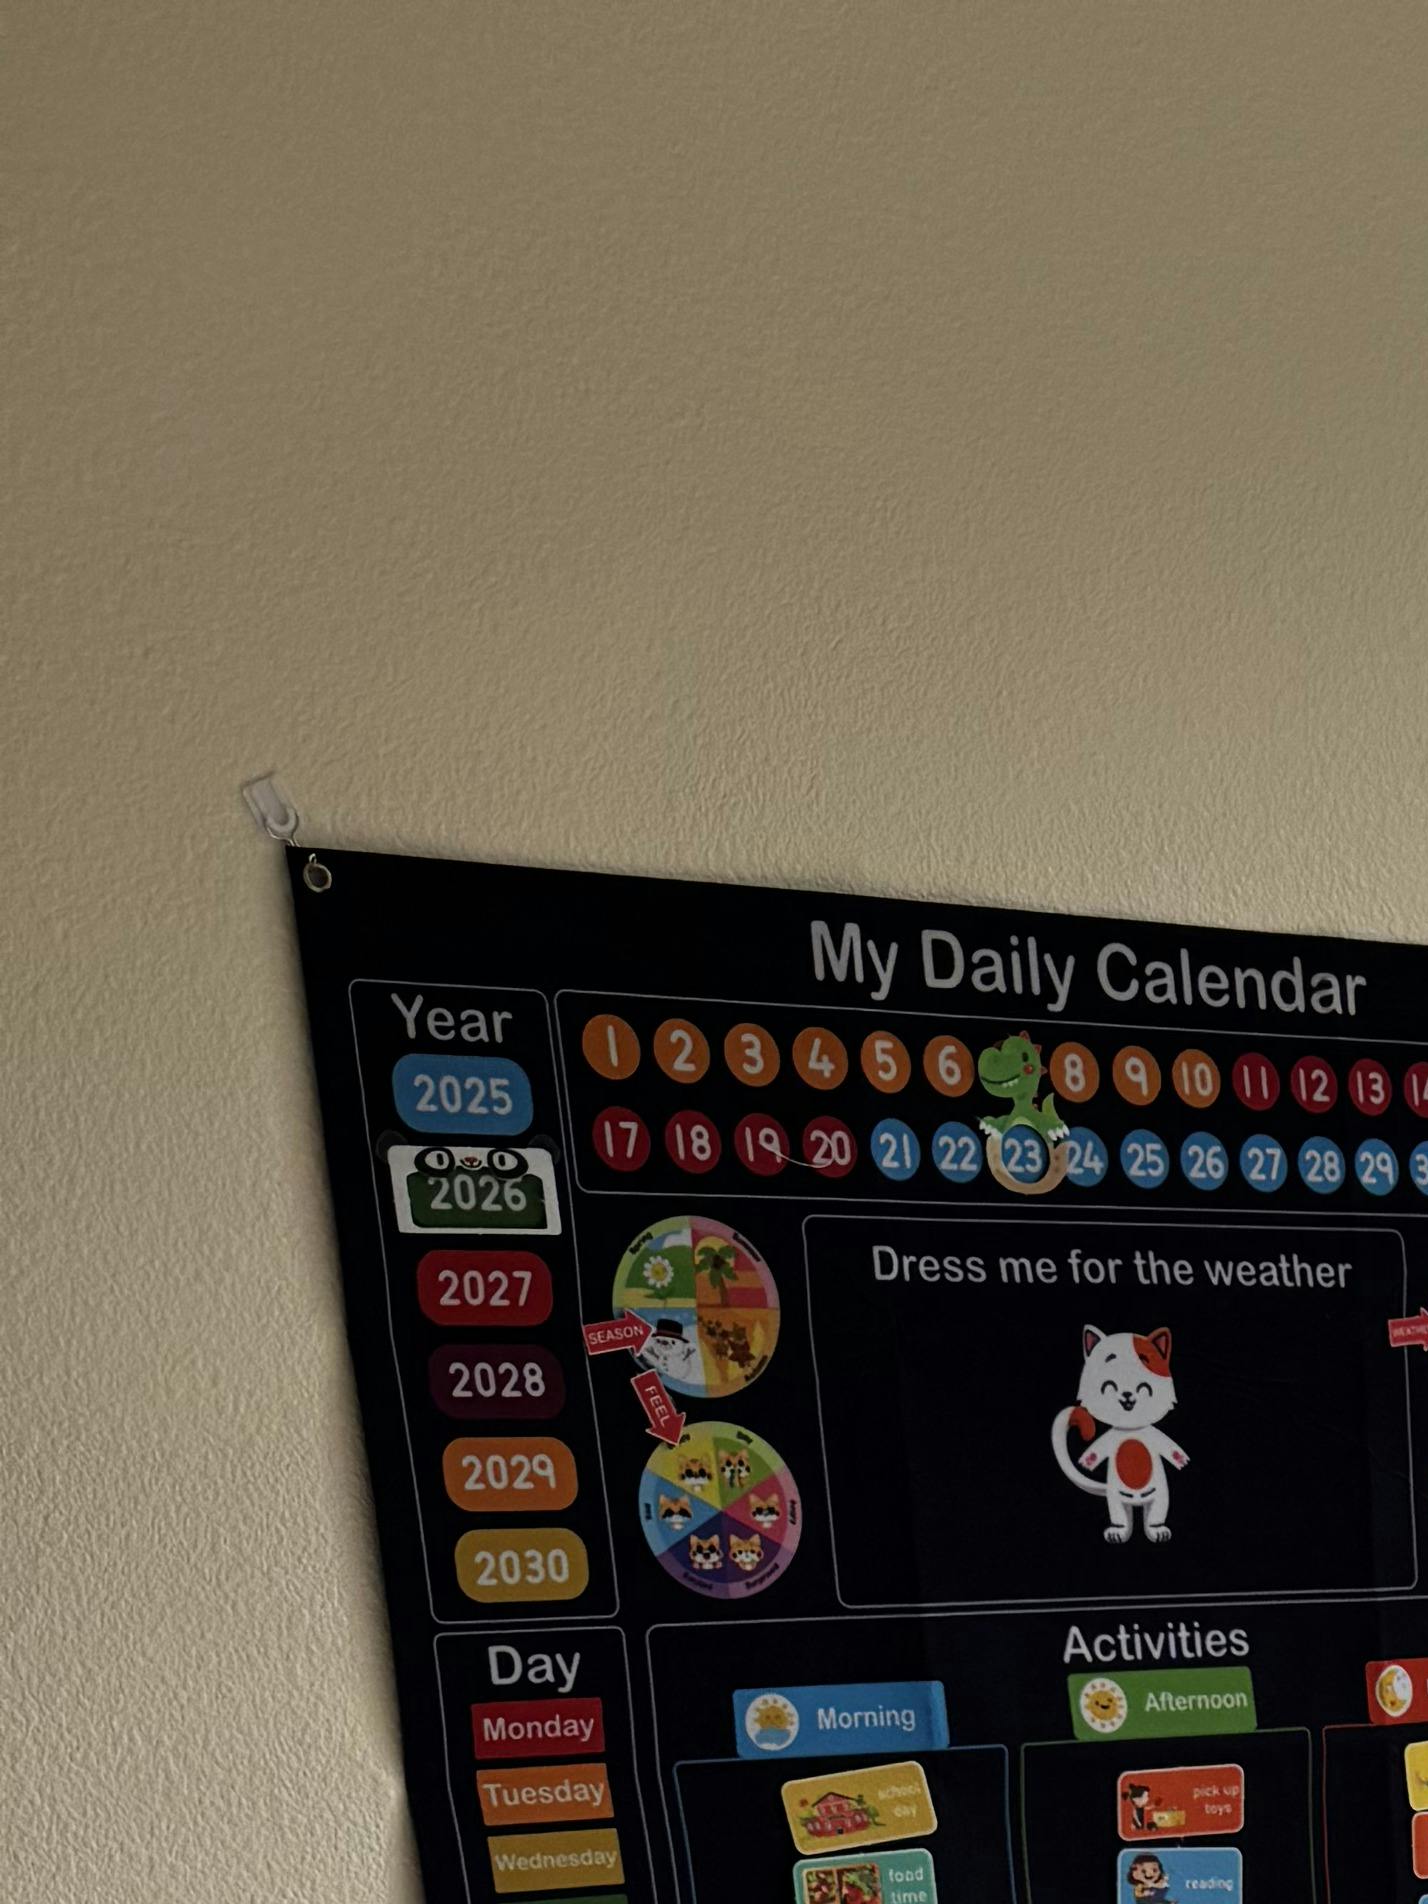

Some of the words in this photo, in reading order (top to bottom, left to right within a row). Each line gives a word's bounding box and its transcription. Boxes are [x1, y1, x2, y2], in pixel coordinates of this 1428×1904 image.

[811, 920, 899, 1001] My
[921, 929, 1075, 1013] Daily
[1097, 942, 1367, 1017] Calendar
[392, 994, 513, 1043] Year
[606, 1025, 619, 1067] 1
[671, 1030, 694, 1073] 2
[742, 1034, 764, 1074] 3
[809, 1037, 836, 1078] 4
[874, 1040, 896, 1081] 5
[938, 1044, 961, 1084] 6
[1064, 1054, 1086, 1091] 8
[1125, 1057, 1149, 1095] 9
[1180, 1062, 1213, 1097] 10
[1242, 1062, 1269, 1099] 11
[1299, 1066, 1328, 1101] 12
[1355, 1068, 1384, 1103] 13
[414, 1074, 513, 1116] 2025
[428, 1174, 528, 1213] 2026
[873, 1245, 986, 1283] Dress
[999, 1260, 1057, 1284] me
[1067, 1251, 1122, 1284] for
[1134, 1253, 1194, 1286] the
[1205, 1256, 1353, 1289] weather
[438, 1270, 533, 1309] 2027
[588, 1323, 645, 1345] SEASON
[448, 1362, 545, 1400] 2028
[645, 1384, 671, 1428] FEEL
[462, 1453, 554, 1494] 2029
[476, 1547, 569, 1586] 2030
[1064, 1622, 1250, 1664] Activities
[488, 1644, 581, 1693] Day
[817, 1706, 916, 1731] Morning
[1144, 1689, 1248, 1713] Afternoon
[483, 1716, 595, 1743] Monday
[482, 1783, 604, 1810] Tuesday
[495, 1848, 618, 1873] Wednesday
[1185, 1877, 1234, 1892] reading
